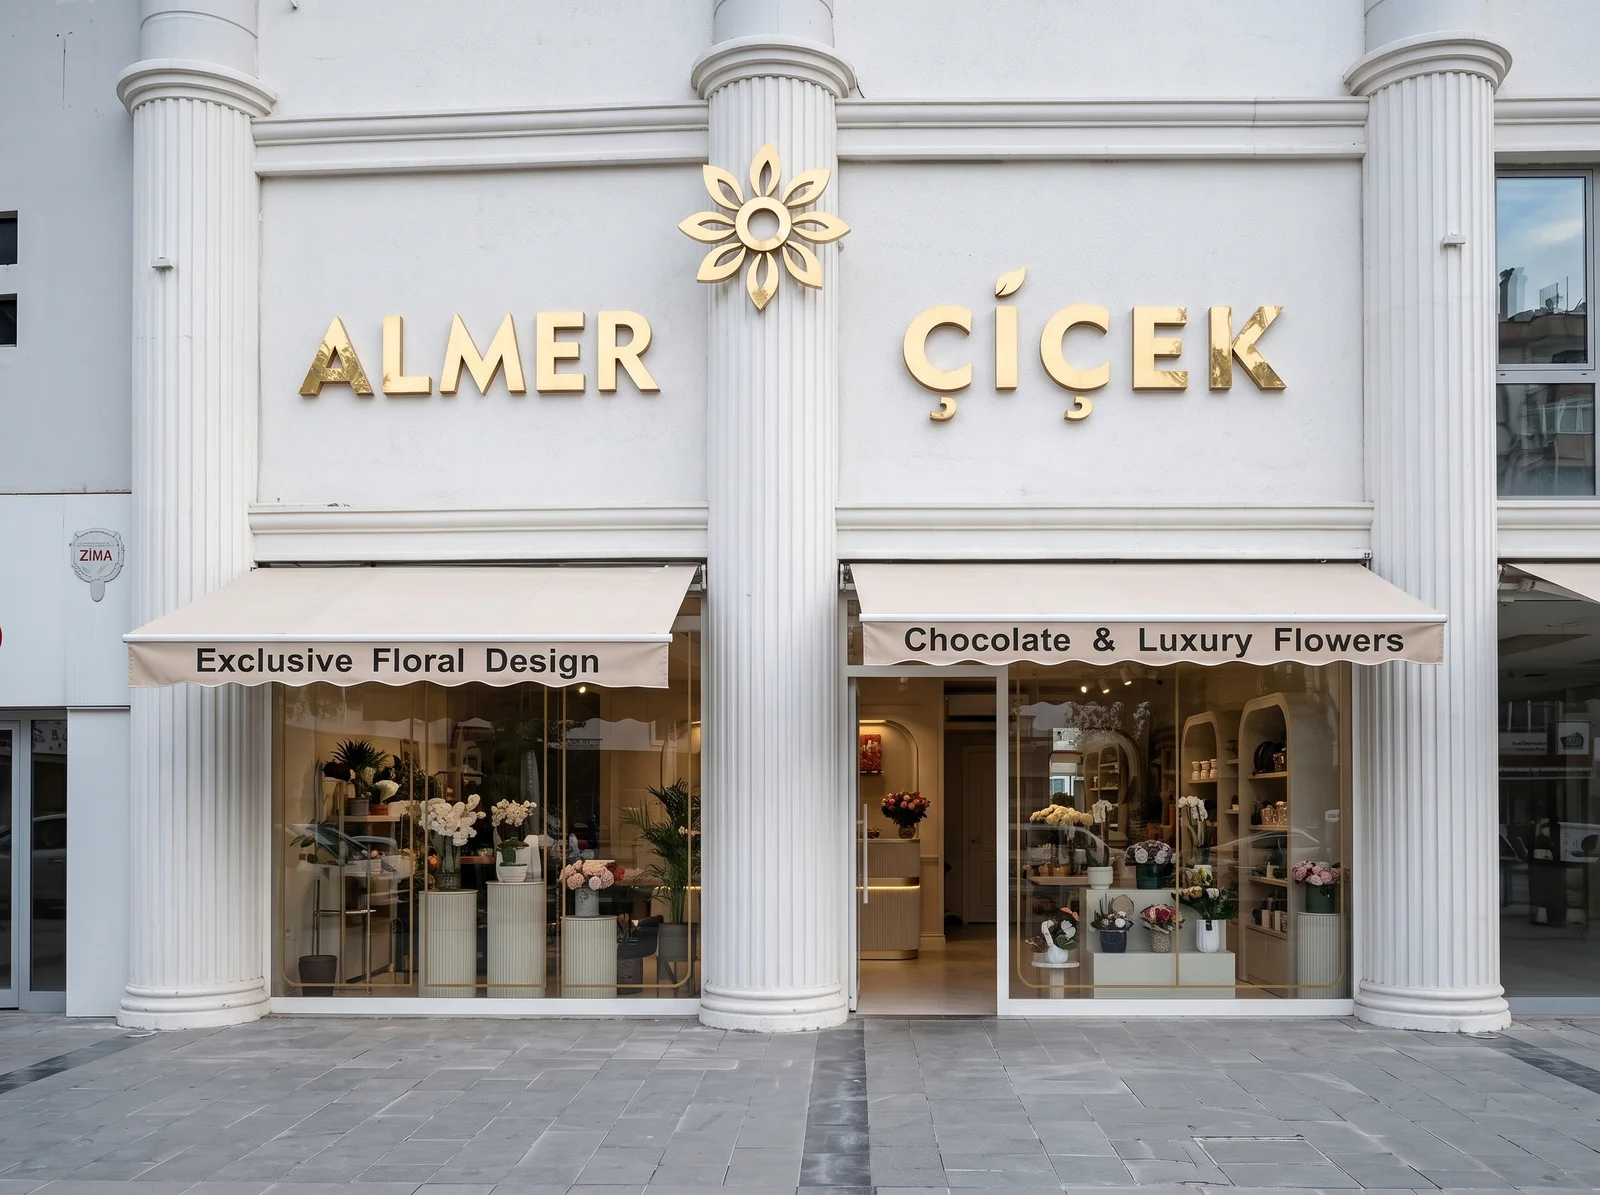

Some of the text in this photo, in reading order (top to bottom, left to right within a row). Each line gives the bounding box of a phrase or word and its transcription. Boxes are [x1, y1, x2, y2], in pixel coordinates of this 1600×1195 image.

[299, 265, 1288, 423] ALMER ÇİÇEK
[79, 547, 113, 562] ZİMA
[905, 628, 1403, 658] Chocolate & Luxury Flowers
[197, 648, 598, 679] Exclusive Floral Design
